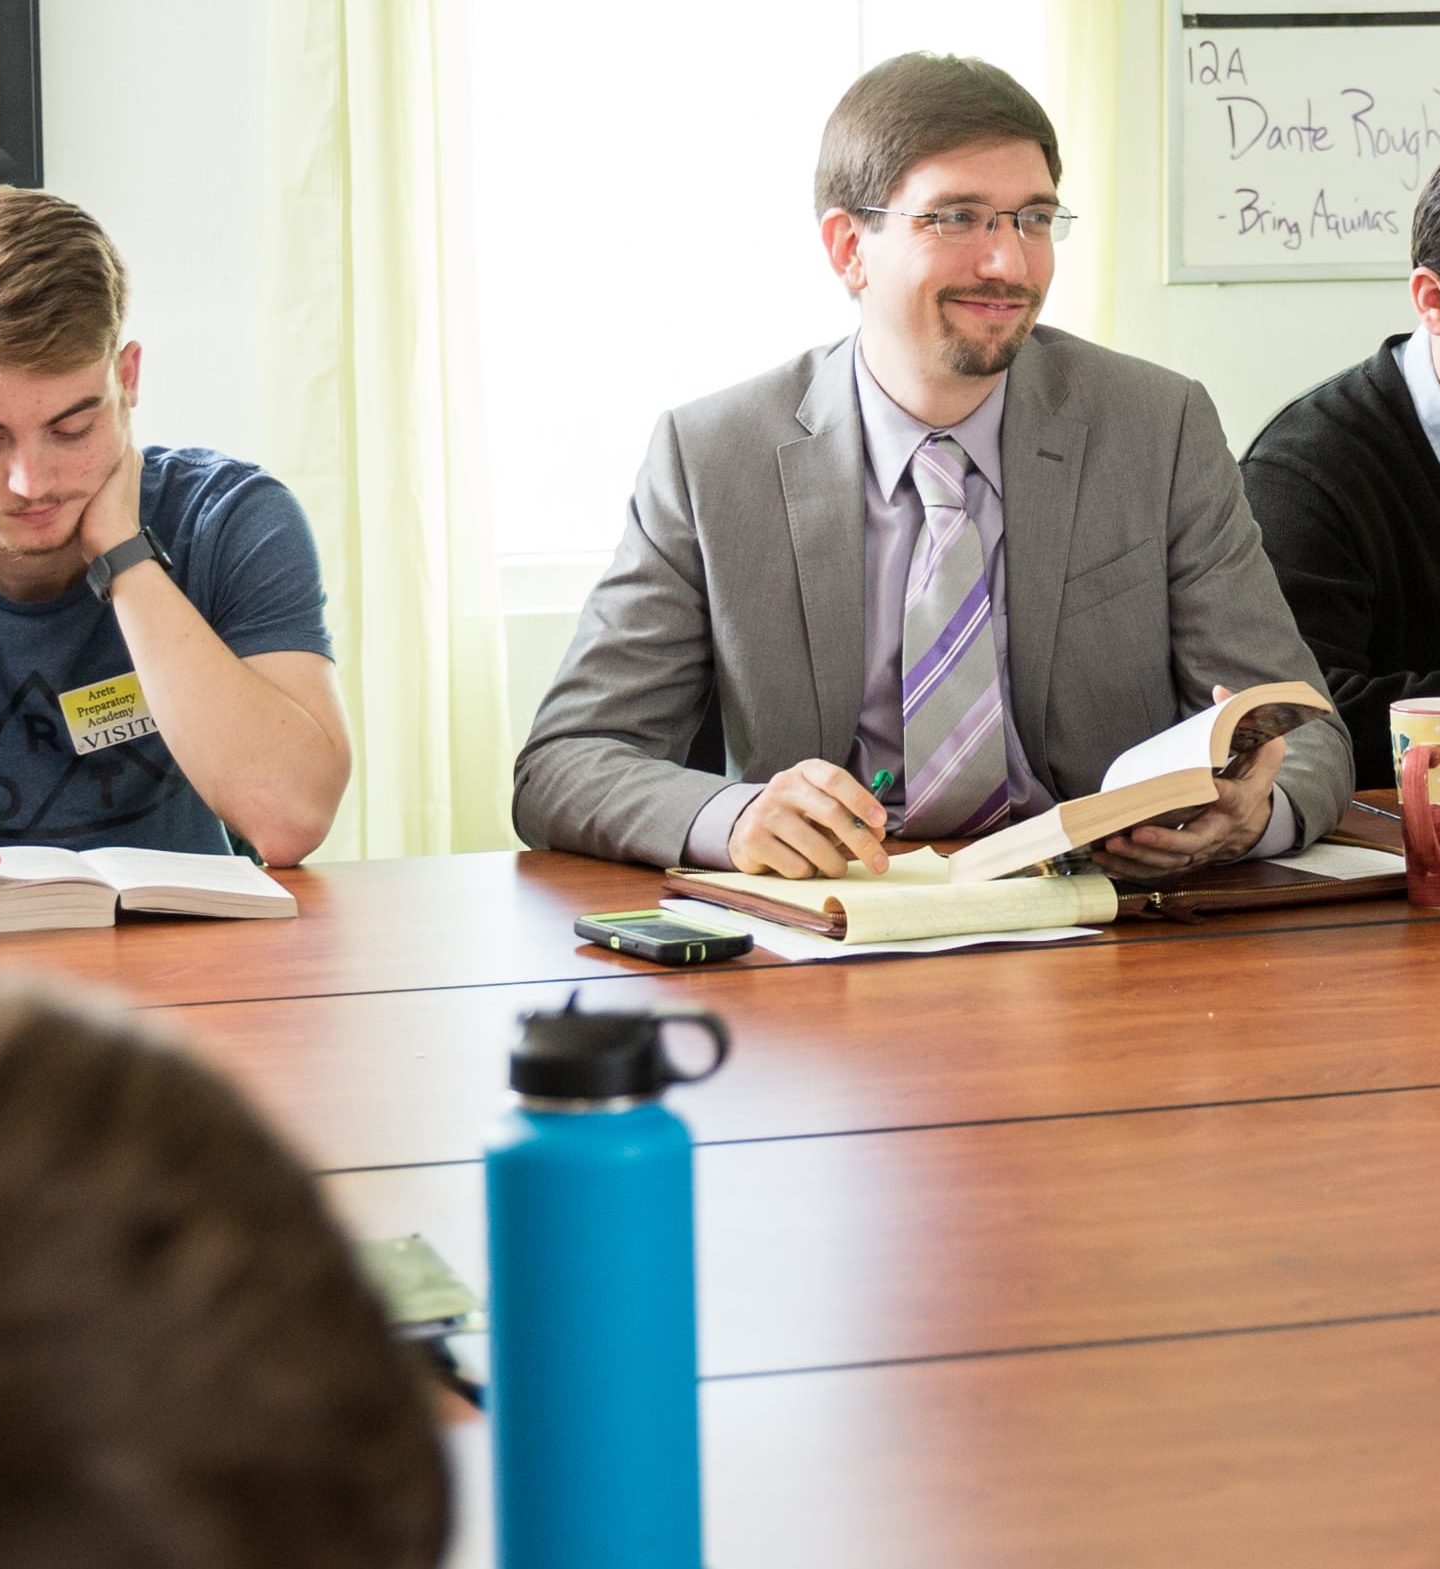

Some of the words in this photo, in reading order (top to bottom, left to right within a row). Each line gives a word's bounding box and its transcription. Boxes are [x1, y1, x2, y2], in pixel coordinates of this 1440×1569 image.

[1187, 41, 1247, 85] 12A
[1216, 96, 1335, 160] Dante
[1235, 188, 1302, 249] Bring
[1310, 189, 1400, 240] Aquinas
[76, 693, 136, 717] Preparatory
[88, 707, 134, 728] Academy
